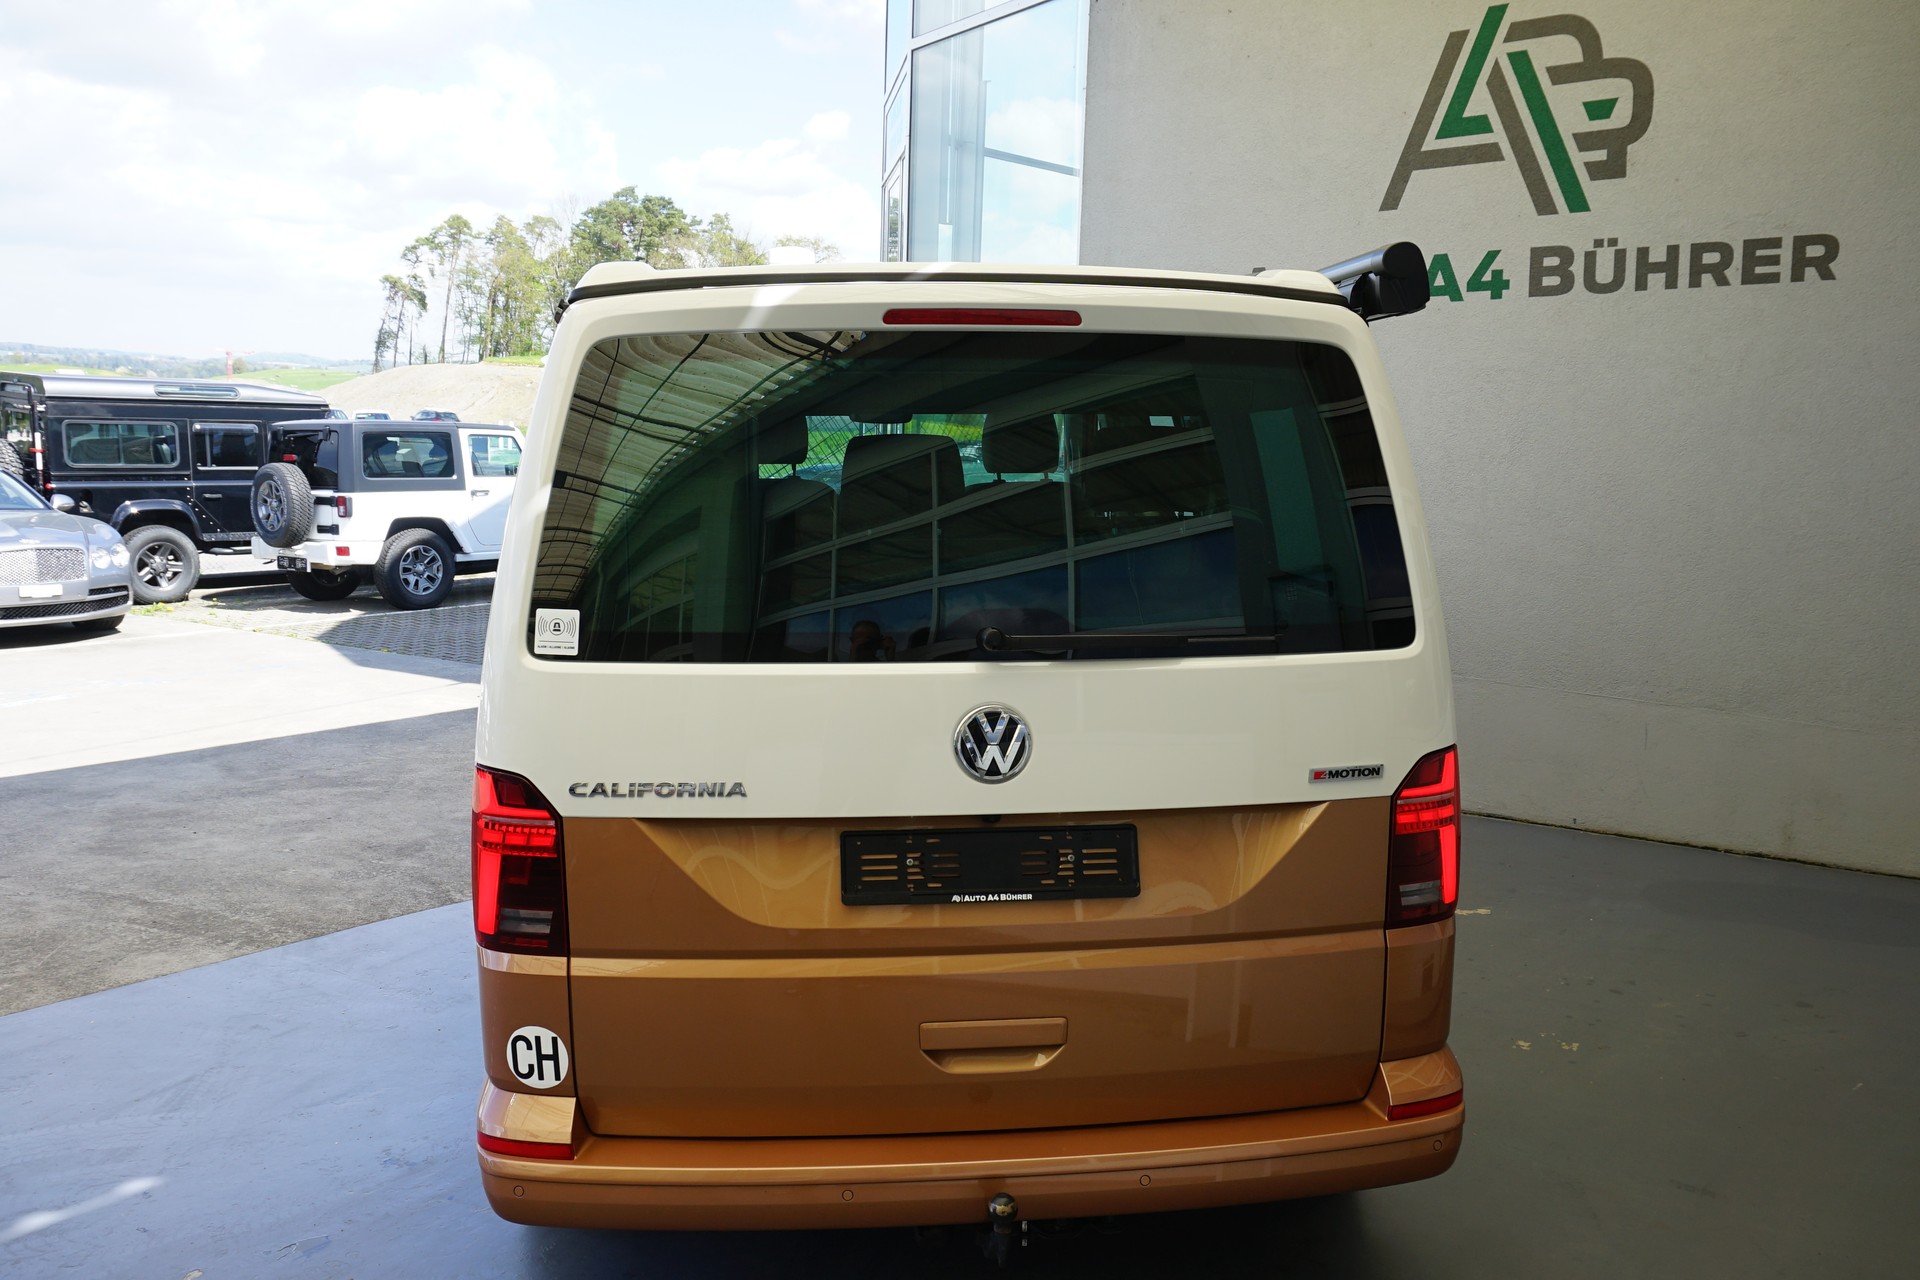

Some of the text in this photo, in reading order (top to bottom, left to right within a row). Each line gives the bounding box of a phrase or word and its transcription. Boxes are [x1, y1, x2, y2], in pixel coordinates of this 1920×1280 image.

[1527, 232, 1841, 299] BÜHRER
[958, 706, 1028, 779] VW
[568, 781, 748, 798] CALIFORNIA
[964, 894, 987, 902] AUTO
[987, 893, 1000, 902] A4
[511, 1034, 562, 1082] CH
